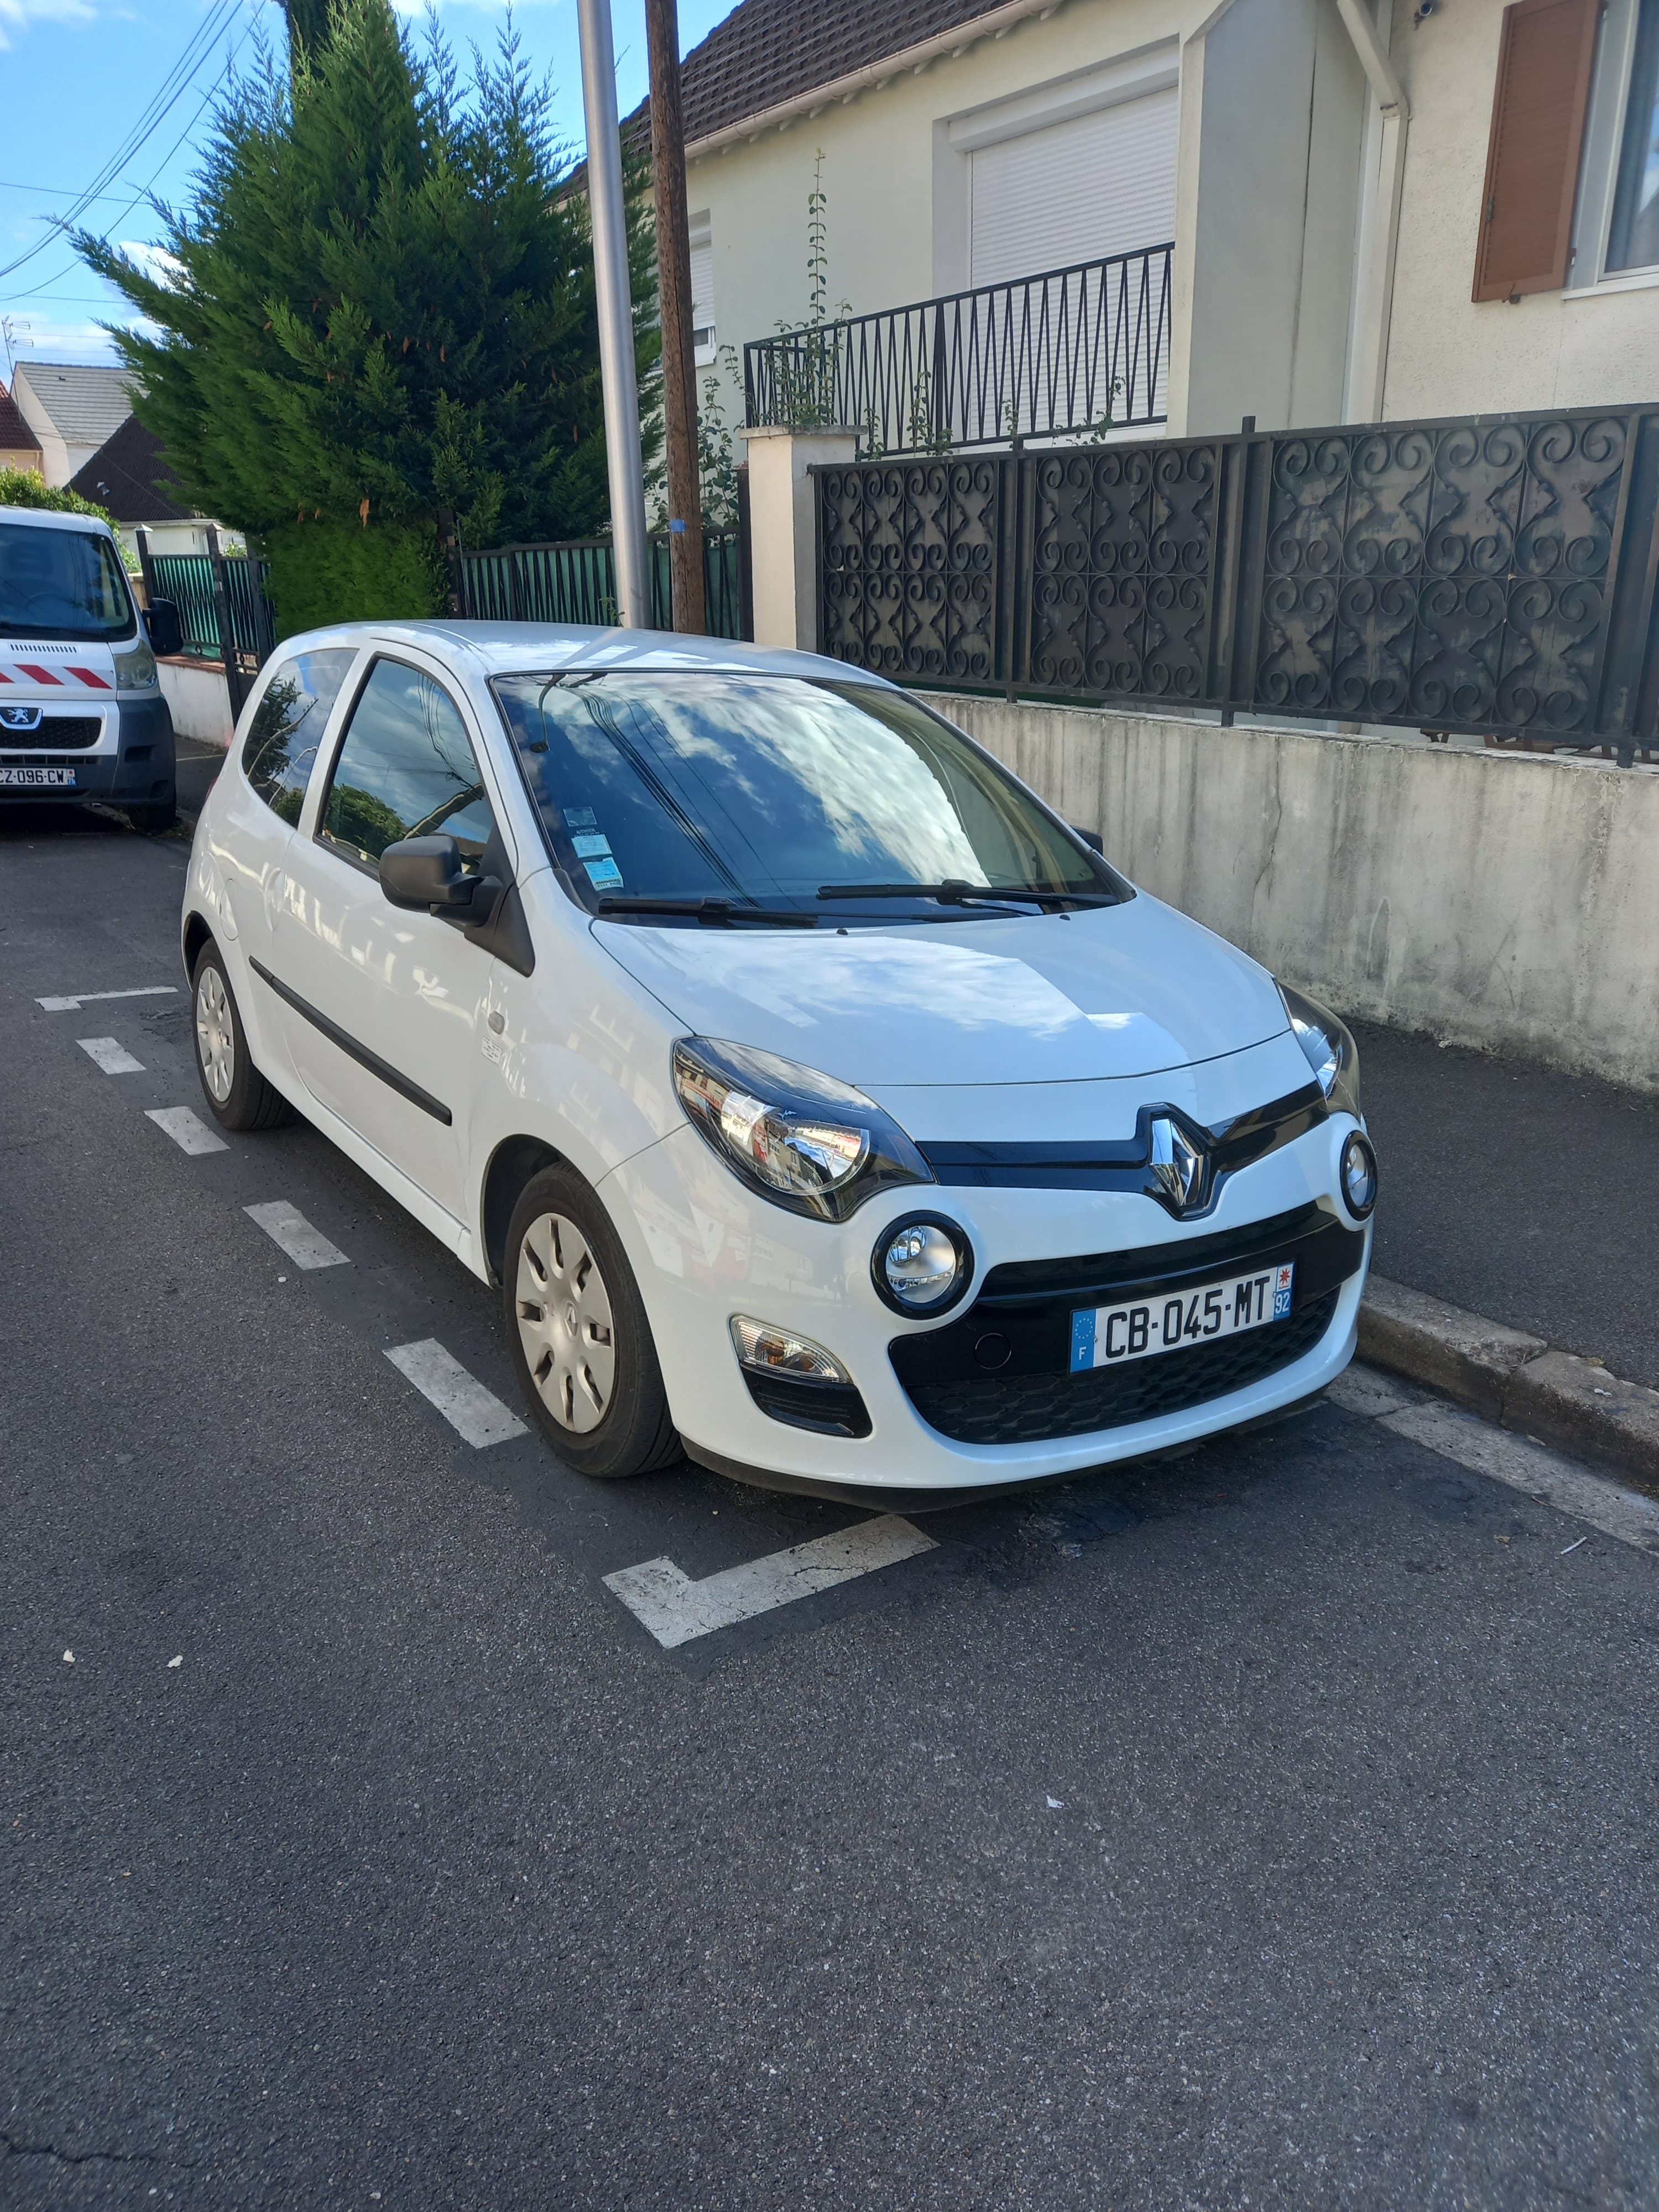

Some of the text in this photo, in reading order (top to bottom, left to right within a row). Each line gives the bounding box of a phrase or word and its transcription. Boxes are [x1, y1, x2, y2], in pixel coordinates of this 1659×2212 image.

[1275, 1291, 1290, 1314] 92
[1105, 1276, 1270, 1359] CB-045-MT
[1079, 1347, 1087, 1360] F
